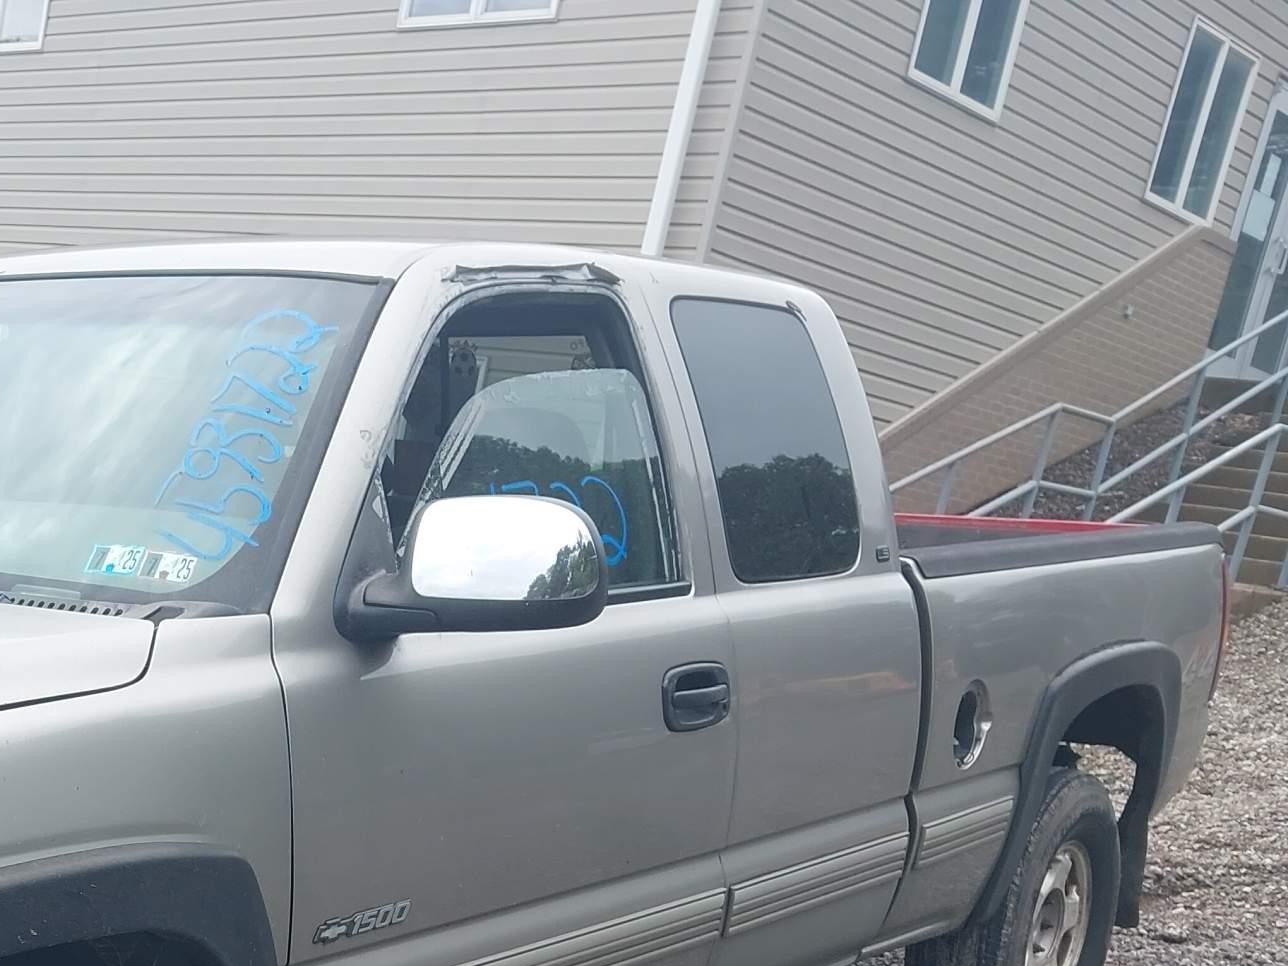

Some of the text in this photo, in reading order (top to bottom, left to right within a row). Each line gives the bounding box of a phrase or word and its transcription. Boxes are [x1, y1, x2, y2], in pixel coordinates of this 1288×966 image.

[122, 549, 141, 570] 25
[176, 558, 195, 580] 25
[351, 898, 412, 936] 1500
